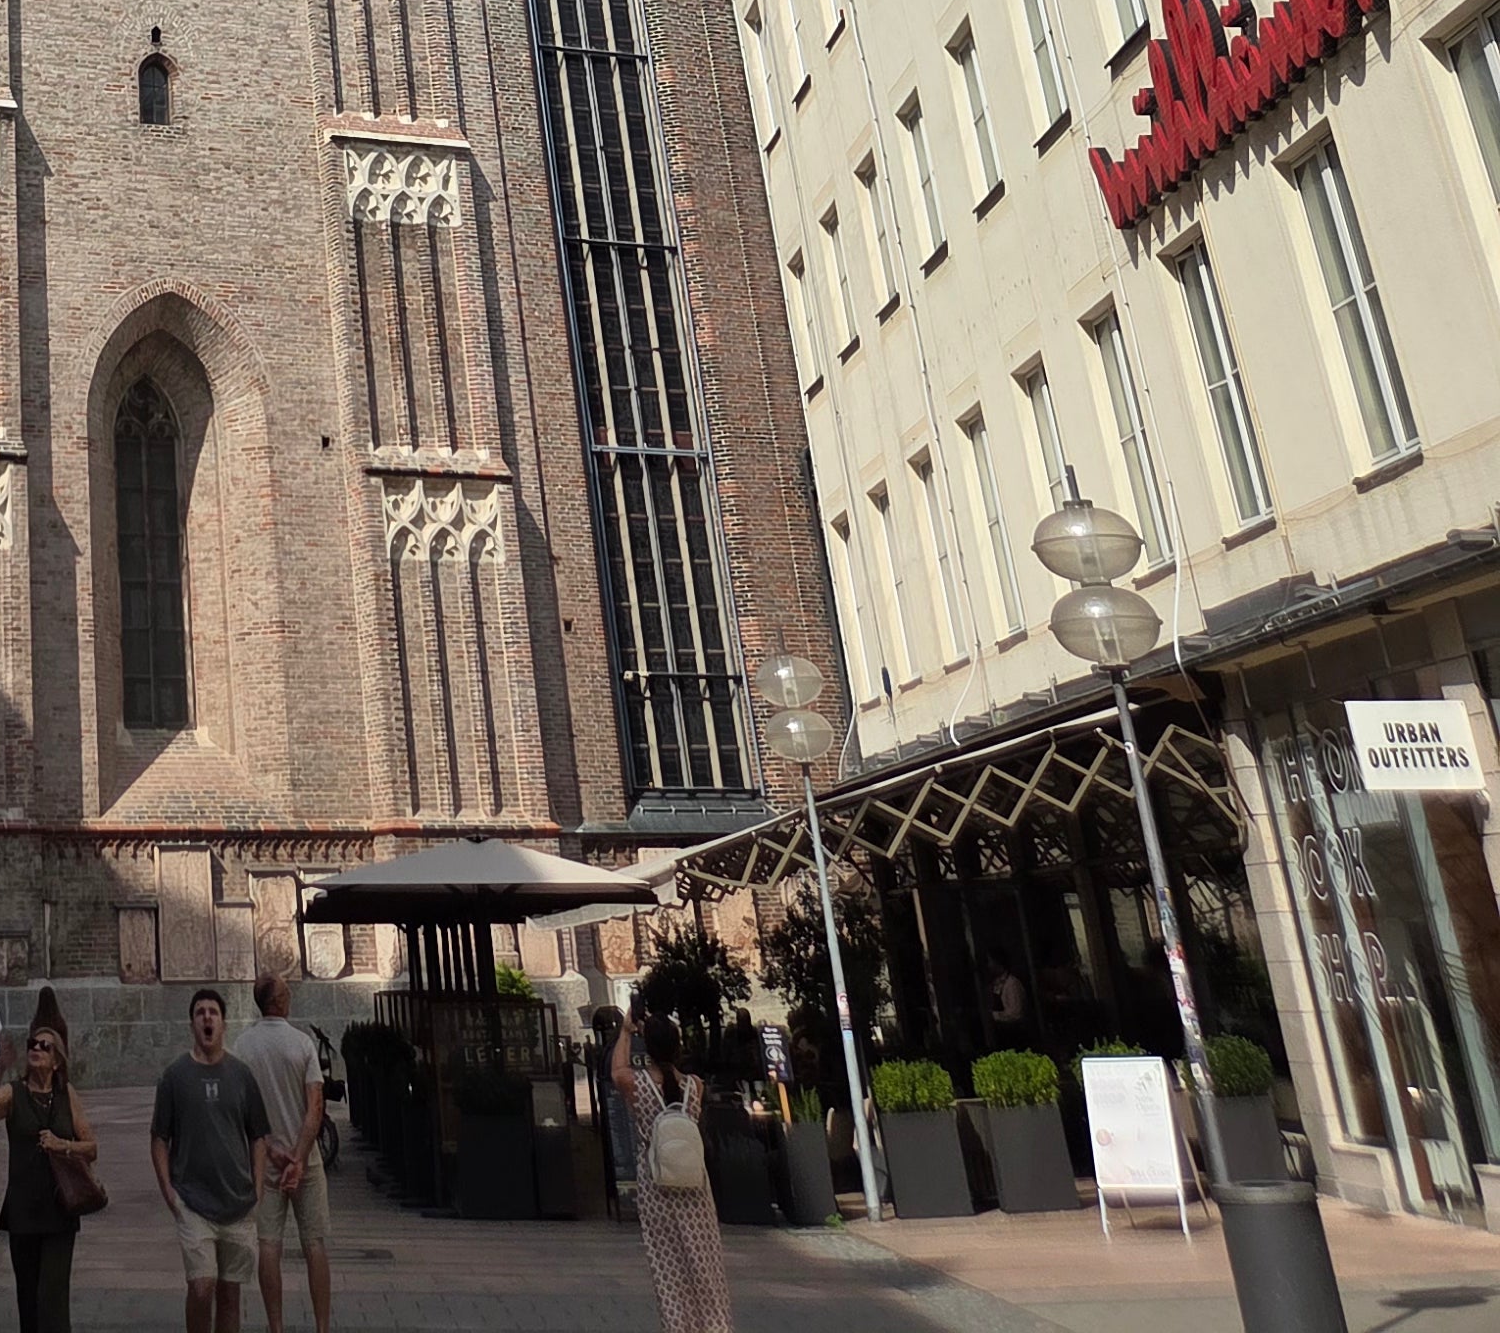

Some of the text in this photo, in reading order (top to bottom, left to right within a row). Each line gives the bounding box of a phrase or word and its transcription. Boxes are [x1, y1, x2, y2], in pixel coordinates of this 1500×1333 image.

[1382, 722, 1442, 743] URBAN
[1367, 747, 1470, 769] OUTFITTERS
[464, 1045, 531, 1062] LEER
